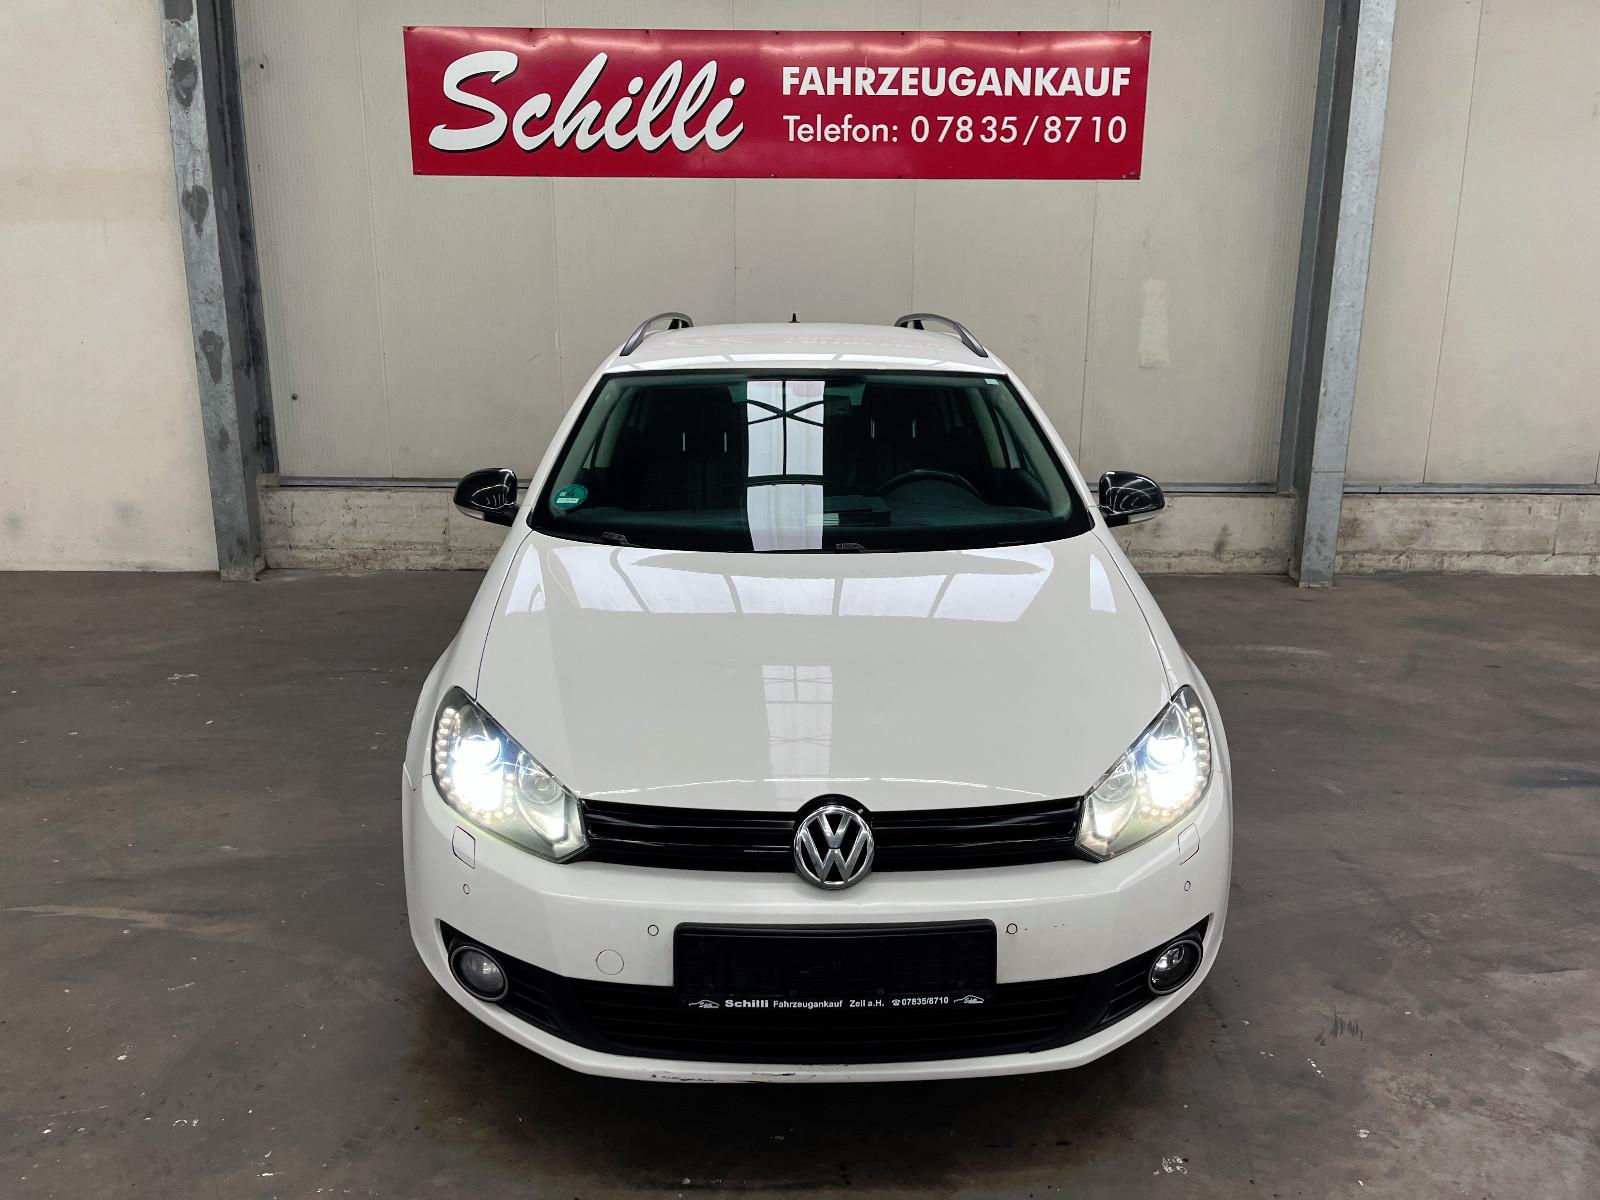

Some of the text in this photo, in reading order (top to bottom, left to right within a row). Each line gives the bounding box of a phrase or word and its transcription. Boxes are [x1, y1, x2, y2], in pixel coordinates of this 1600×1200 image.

[782, 65, 1132, 97] FAHRZEUGANKAUF
[428, 50, 745, 153] Schilli
[783, 113, 898, 143] Telefon:
[724, 999, 769, 1008] Schilli
[773, 1000, 843, 1010] Fahrzeugankauf
